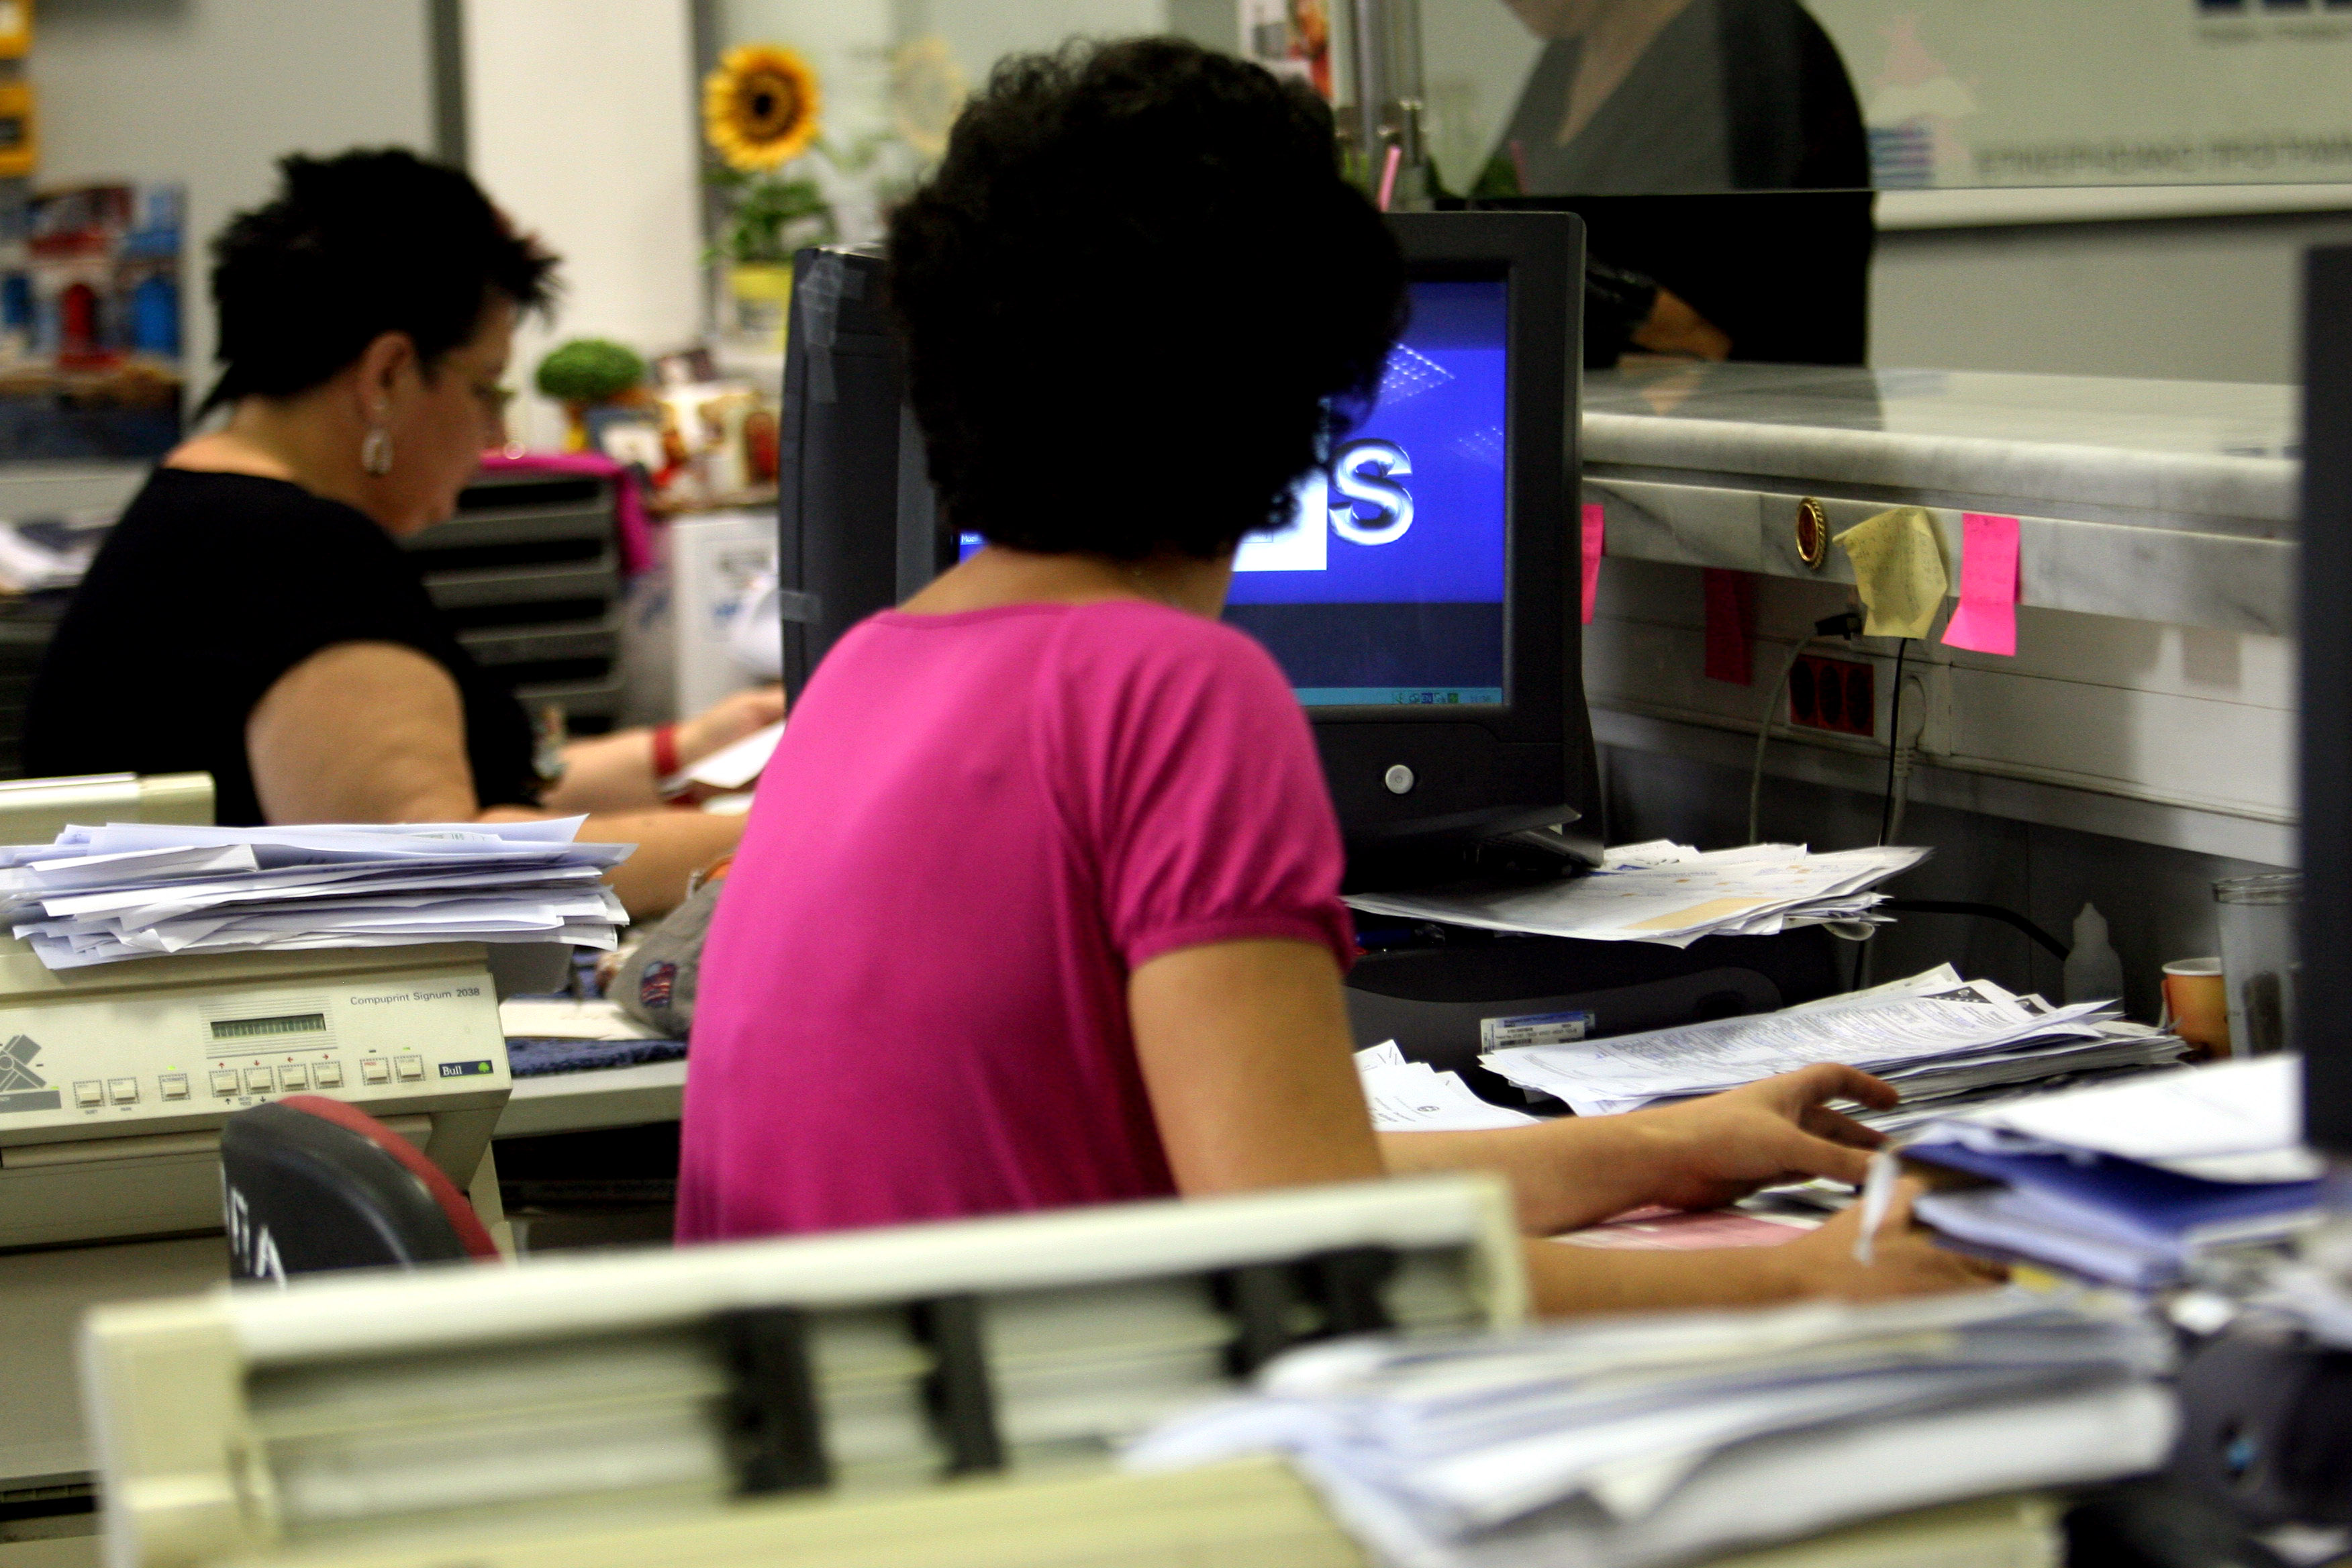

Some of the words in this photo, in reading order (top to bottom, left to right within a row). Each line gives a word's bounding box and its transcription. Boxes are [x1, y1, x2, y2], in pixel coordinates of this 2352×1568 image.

[350, 993, 409, 1006] Compuprint
[413, 990, 451, 1001] Signum
[456, 987, 480, 997] 2038
[442, 1065, 462, 1075] Bull
